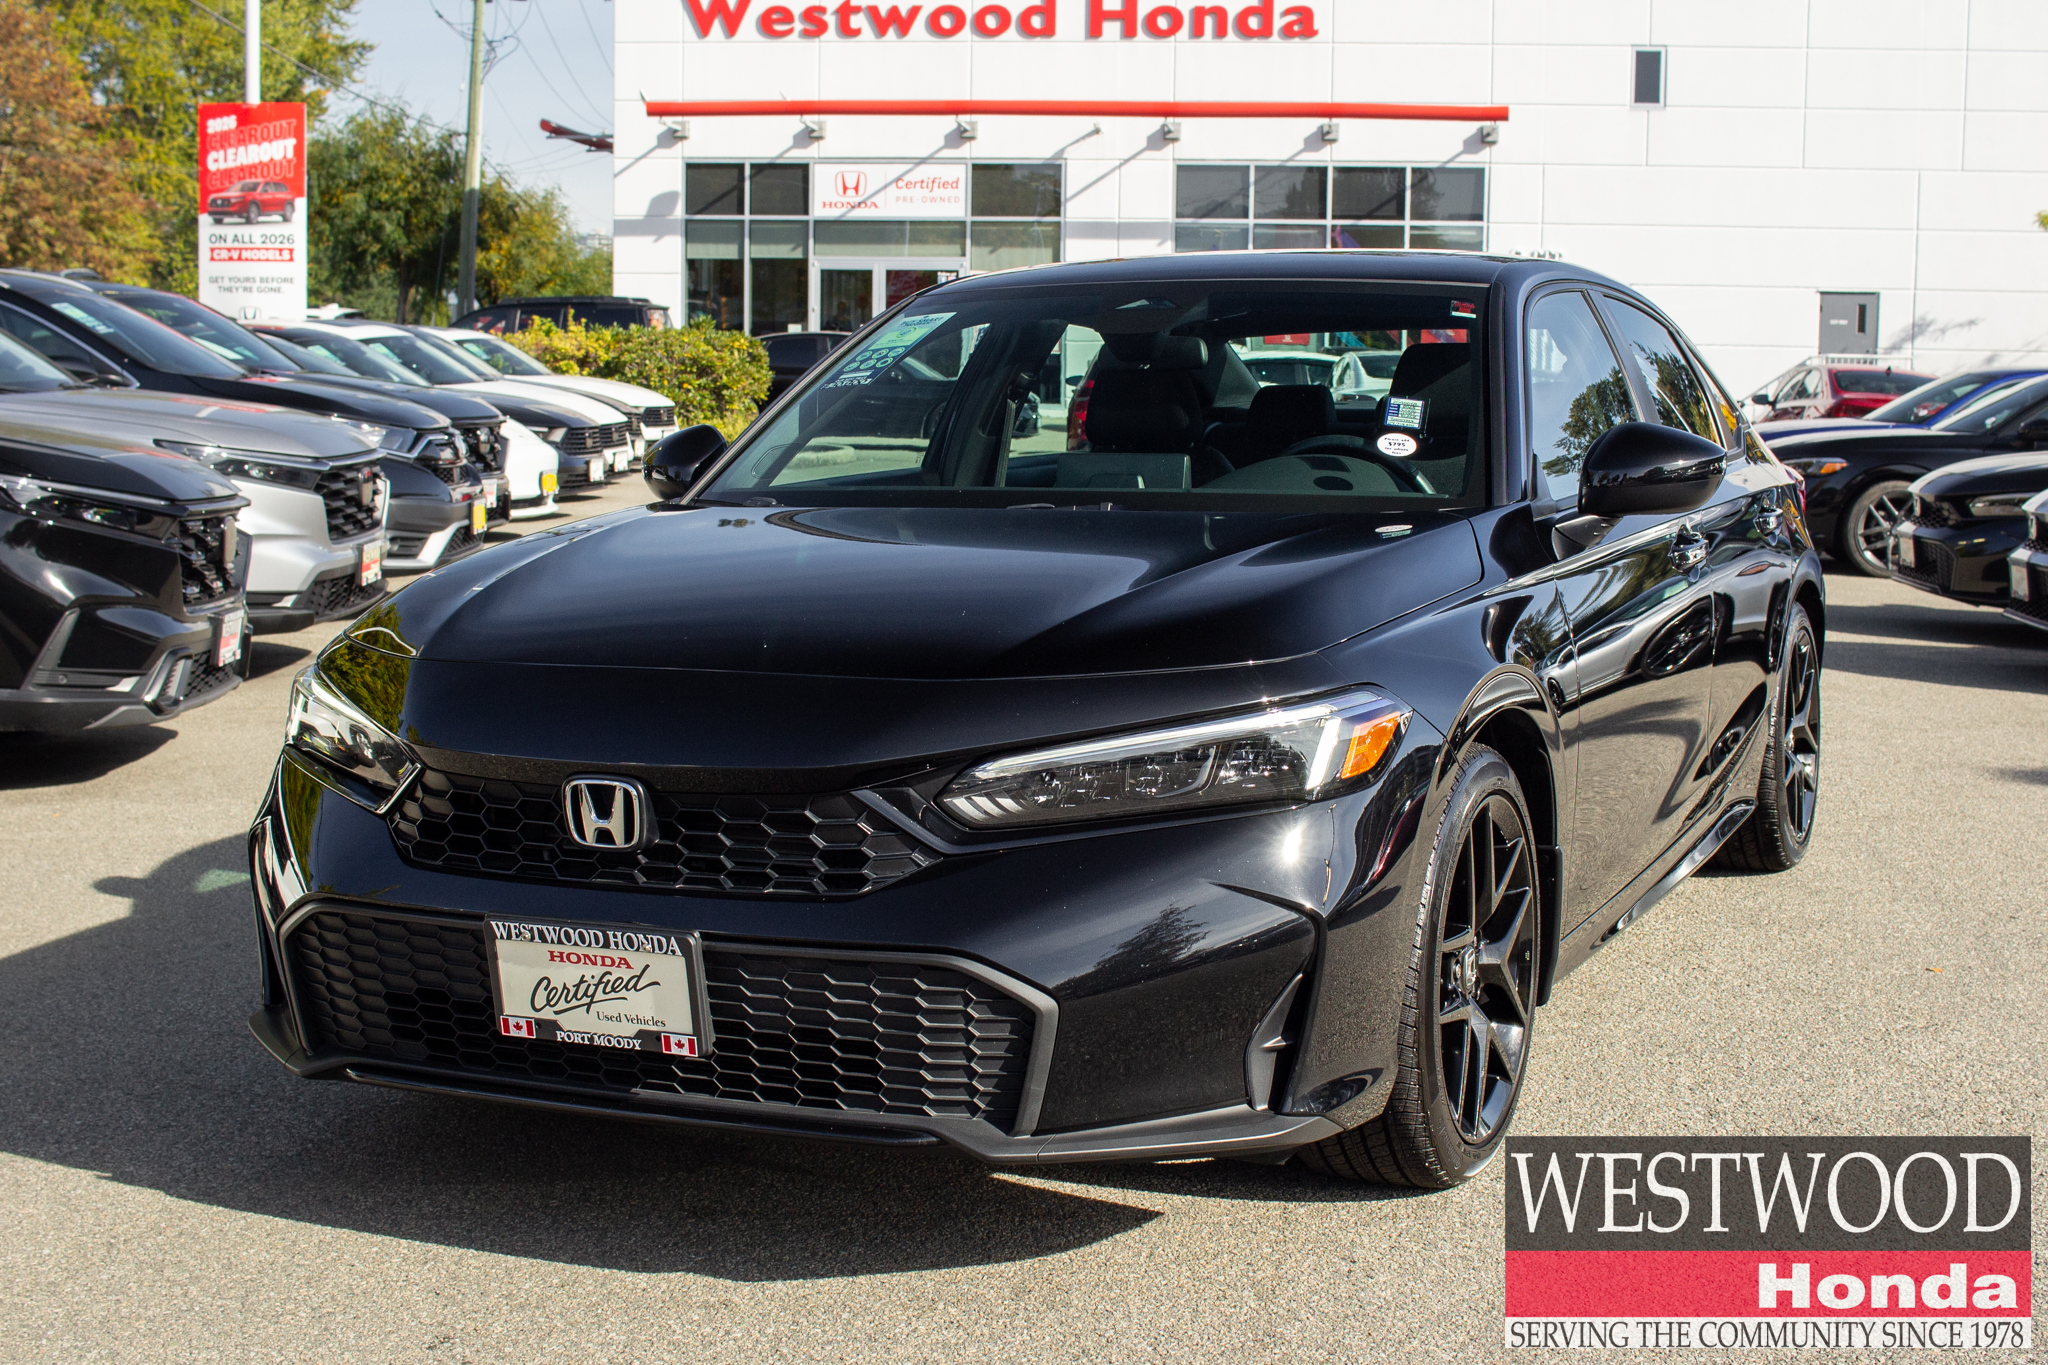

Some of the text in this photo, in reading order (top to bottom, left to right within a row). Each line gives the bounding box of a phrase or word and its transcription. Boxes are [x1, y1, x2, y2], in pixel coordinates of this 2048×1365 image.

[686, 0, 1319, 38] Westwood Honda
[206, 118, 297, 152] CLEAROUT
[206, 137, 297, 172] CLEAROUT
[894, 177, 960, 193] Certified
[821, 200, 880, 209] HONDA
[895, 195, 961, 204] PRE-OWNED
[208, 233, 295, 245] ON ALL 2026
[212, 248, 291, 261] CR-V MODELS
[208, 275, 295, 285] GET YOURS BEFORE
[490, 921, 683, 956] WESTWOOD HONDA
[548, 950, 635, 970] HONDA
[530, 964, 662, 1015] Certified
[596, 1010, 666, 1028] Used Vehicles
[556, 1030, 642, 1050] PORT MOODY
